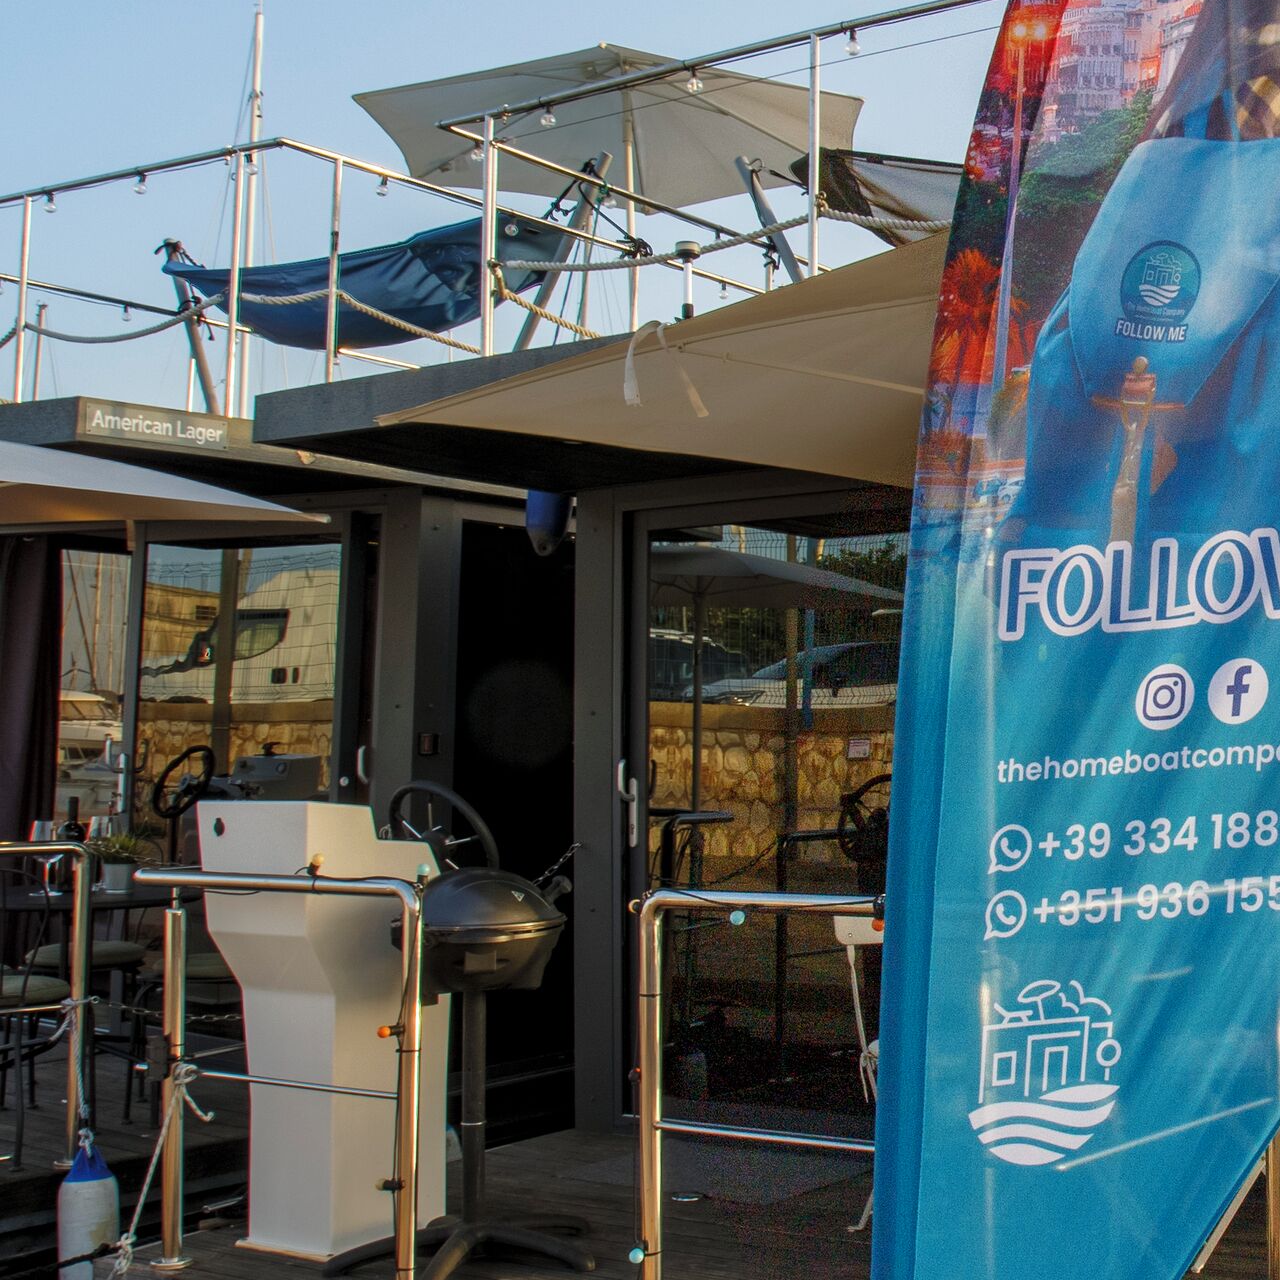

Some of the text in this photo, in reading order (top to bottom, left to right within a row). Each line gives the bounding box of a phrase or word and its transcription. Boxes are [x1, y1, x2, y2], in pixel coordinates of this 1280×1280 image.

[1115, 320, 1187, 341] FOLLOW ME
[92, 410, 223, 444] American Lager
[1038, 822, 1111, 860] +39
[1123, 816, 1199, 856] 334
[1211, 810, 1279, 849] 188
[1033, 887, 1123, 926] +351
[1136, 880, 1211, 920] 936
